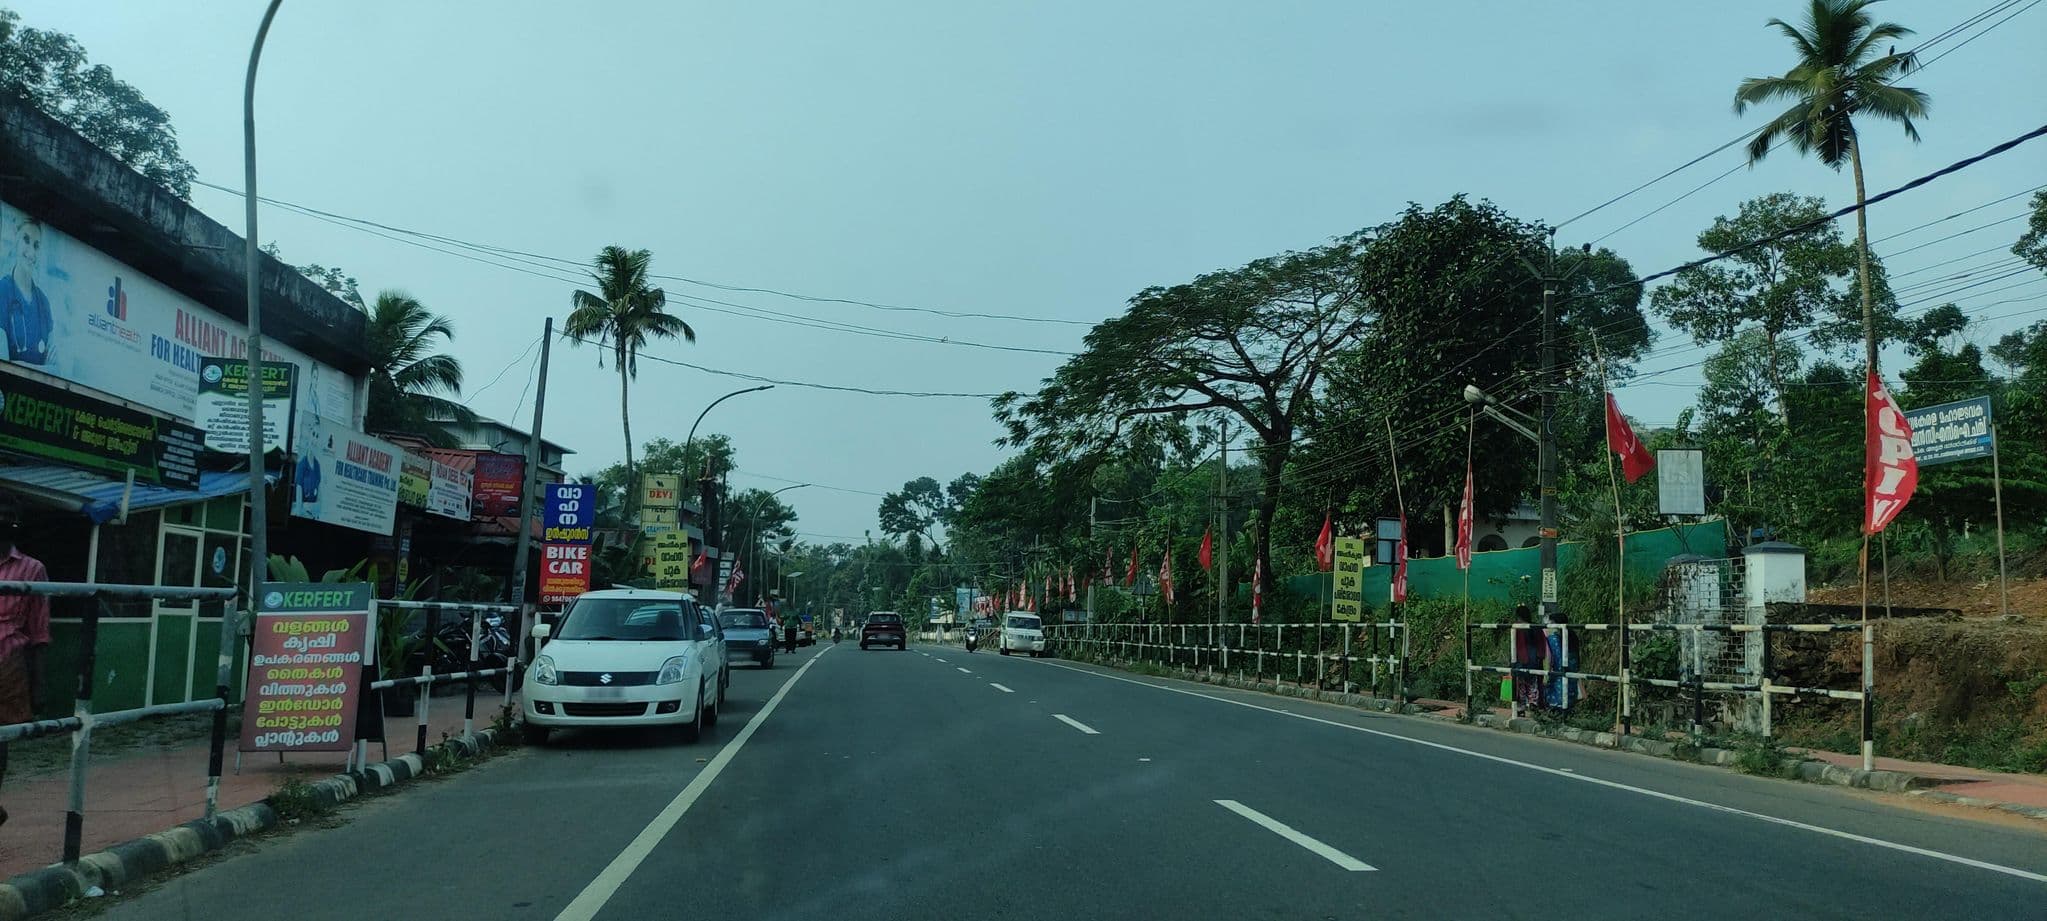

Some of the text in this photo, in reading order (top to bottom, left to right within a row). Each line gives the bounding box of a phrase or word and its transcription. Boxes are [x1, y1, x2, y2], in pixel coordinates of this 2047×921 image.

[175, 308, 228, 357] ALLIANT
[151, 333, 170, 363] FOR
[224, 364, 288, 380] KERERT
[4, 391, 75, 438] KERFERT
[649, 490, 673, 499] DEVI
[546, 546, 587, 560] BIKE
[549, 561, 583, 574] CAR
[283, 591, 355, 608] KERFERT
[272, 618, 350, 635] വളങ്ങൾ
[283, 632, 337, 653] കൃഷി
[253, 651, 360, 666] ഉപകരണങ്ങൾ
[267, 666, 344, 680] തൈകൾ
[259, 682, 347, 697] വിത്തുകൾ
[259, 697, 343, 713] ഇൻഡോർ
[256, 714, 342, 730] പോട്ടുകൾ
